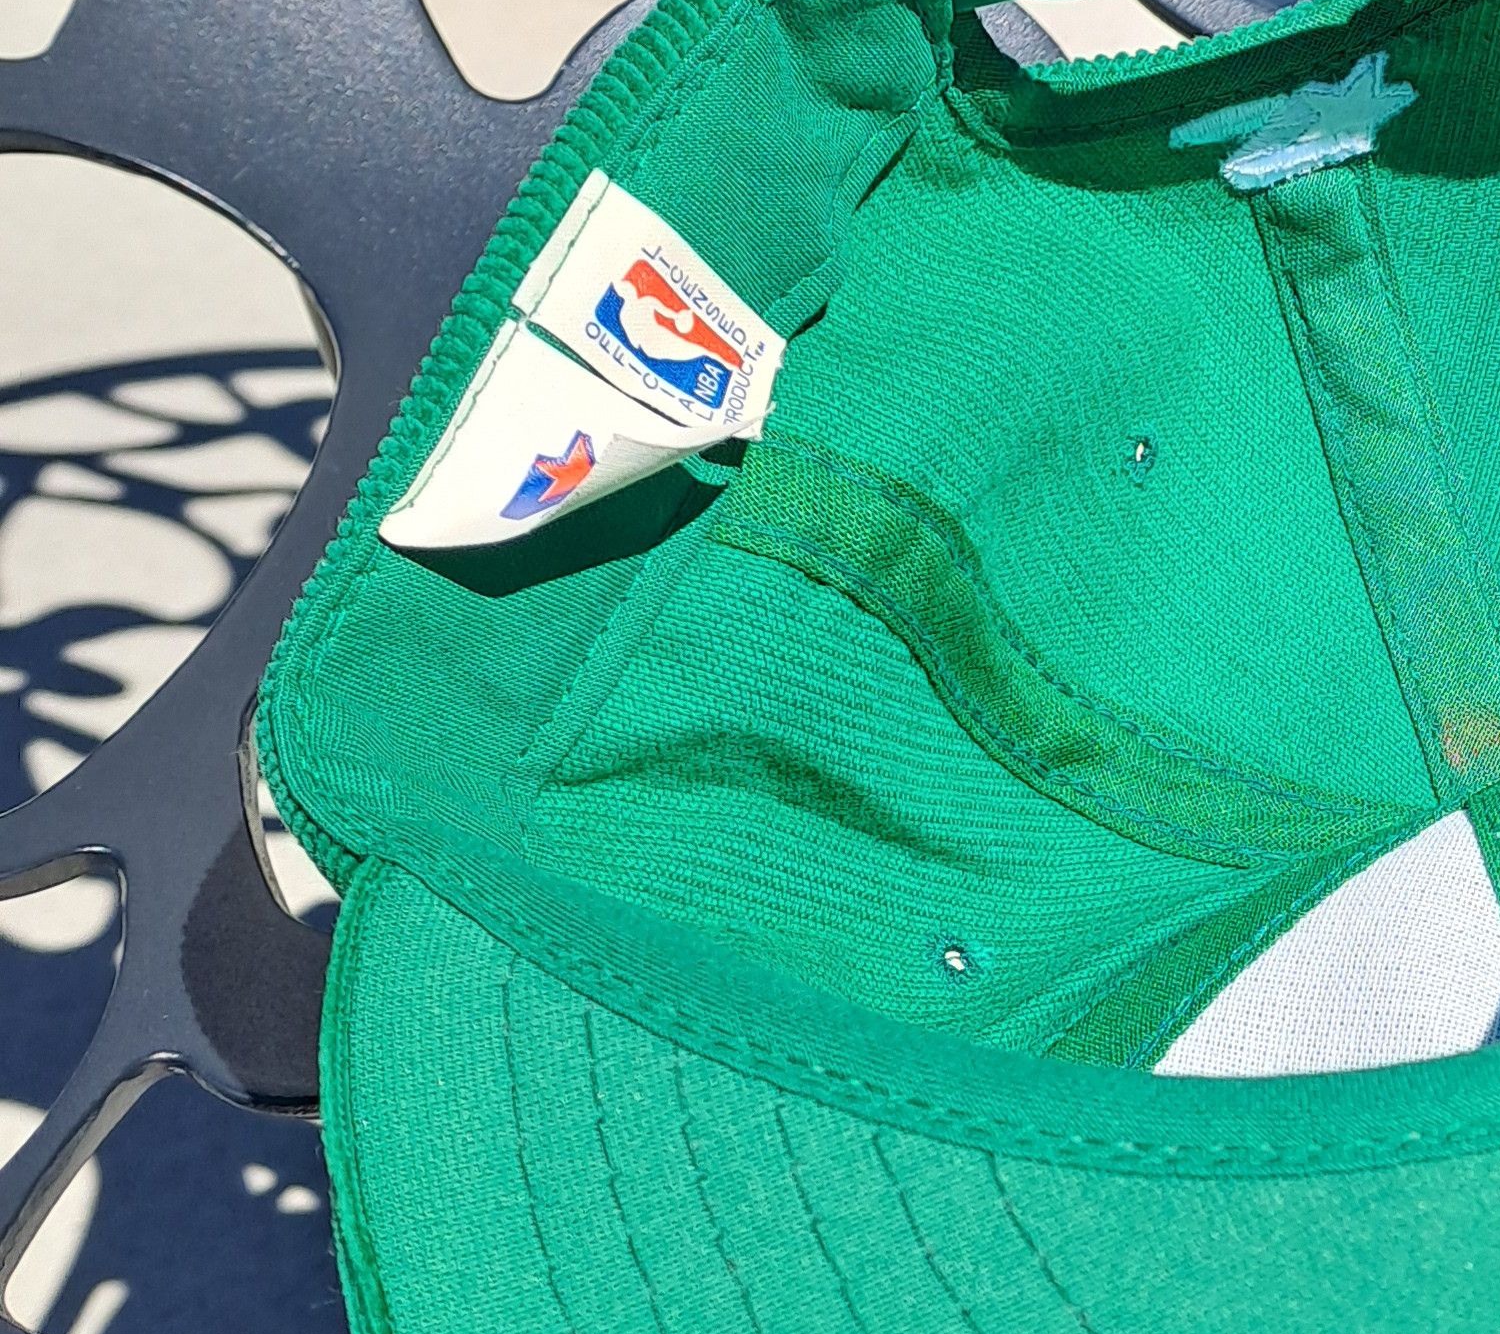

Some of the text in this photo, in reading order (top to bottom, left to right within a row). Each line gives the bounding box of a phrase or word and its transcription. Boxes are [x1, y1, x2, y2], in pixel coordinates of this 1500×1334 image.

[641, 245, 748, 345] LICENSED
[585, 321, 714, 422] OFFICIAL
[693, 362, 724, 403] NBA
